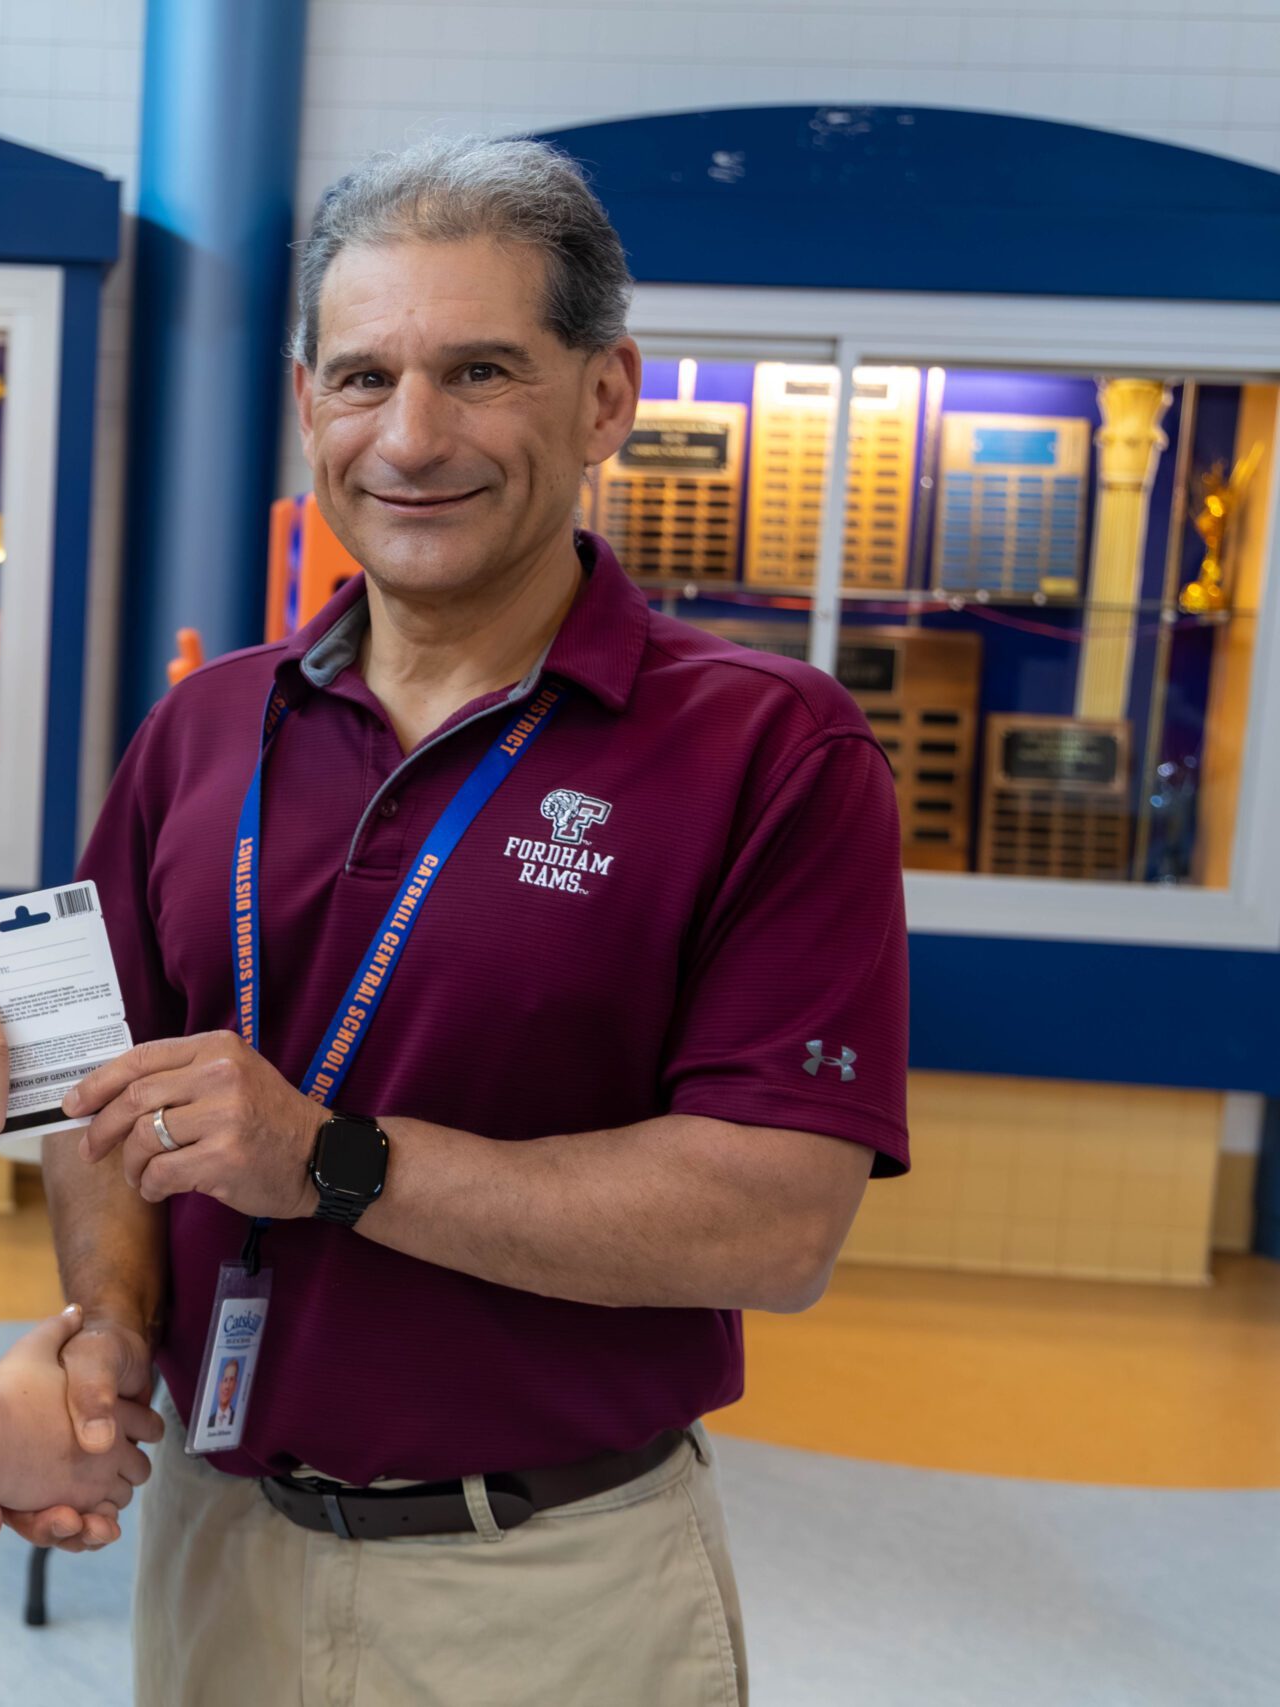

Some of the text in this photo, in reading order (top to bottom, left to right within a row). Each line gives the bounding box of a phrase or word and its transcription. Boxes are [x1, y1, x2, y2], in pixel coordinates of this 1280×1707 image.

[500, 690, 558, 757] DISTRICT
[236, 837, 254, 912] DISTRICT
[503, 836, 615, 876] FORDHAM
[518, 862, 581, 893] RAMS
[390, 853, 440, 931] CATSKILL
[237, 913, 253, 982] SCHOOL
[353, 931, 401, 1005] CENTRAL
[321, 1005, 367, 1074] SCHOOL
[9, 1080, 34, 1090] RATCH
[35, 1076, 49, 1085] OFF
[50, 1070, 78, 1081] GENTLY
[78, 1066, 97, 1077] WITH
